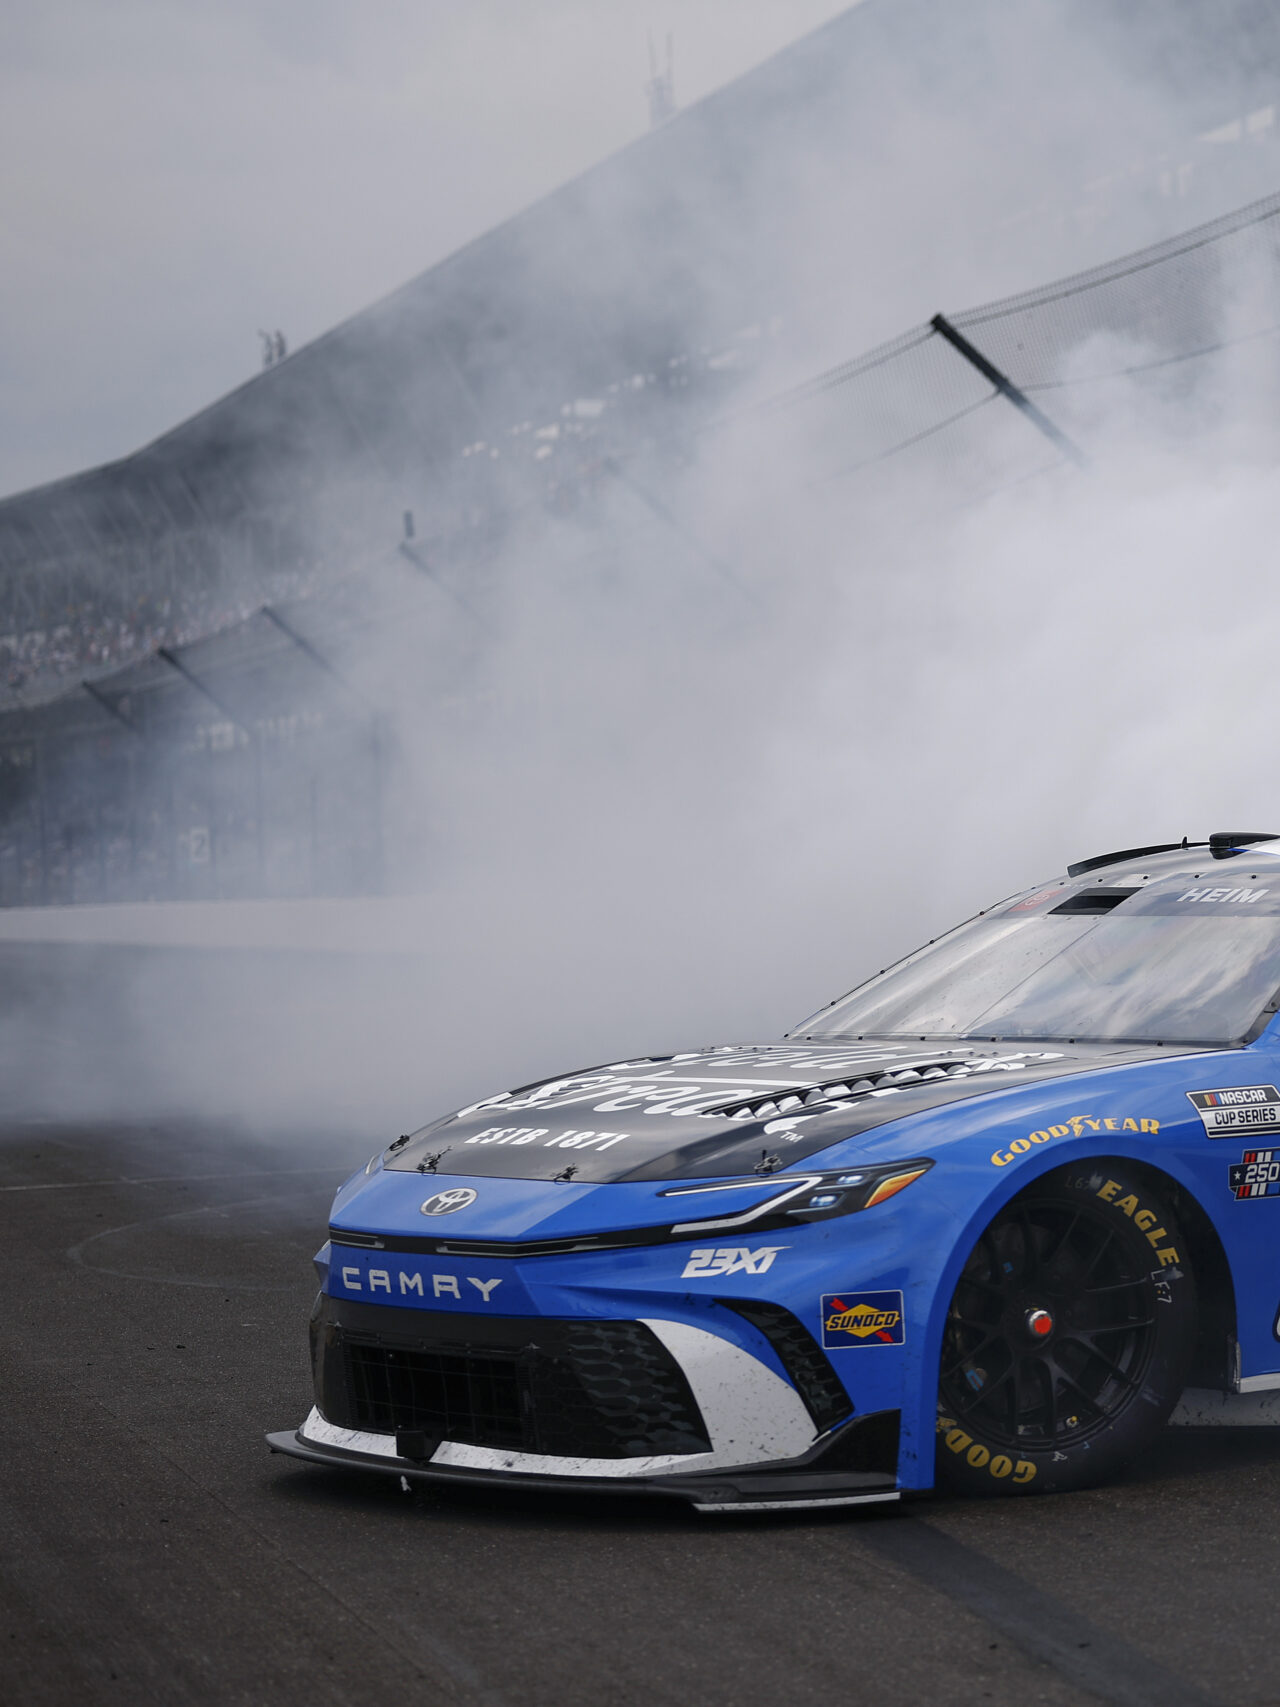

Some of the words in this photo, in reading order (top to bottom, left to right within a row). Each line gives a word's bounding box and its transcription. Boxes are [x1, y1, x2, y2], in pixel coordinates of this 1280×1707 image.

[1177, 887, 1270, 903] HEIM
[1219, 1089, 1268, 1105] NASCAR
[1214, 1111, 1237, 1126] CUP
[1238, 1108, 1277, 1123] SERIES
[464, 1127, 550, 1145] ESTB
[543, 1130, 631, 1151] 1871
[780, 1131, 804, 1143] TM
[990, 1116, 1161, 1167] GOODYEAR
[1244, 1162, 1280, 1184] 250
[1096, 1179, 1181, 1267] EAGLE
[342, 1266, 503, 1302] CAMRY
[829, 1312, 899, 1330] SUNOCO
